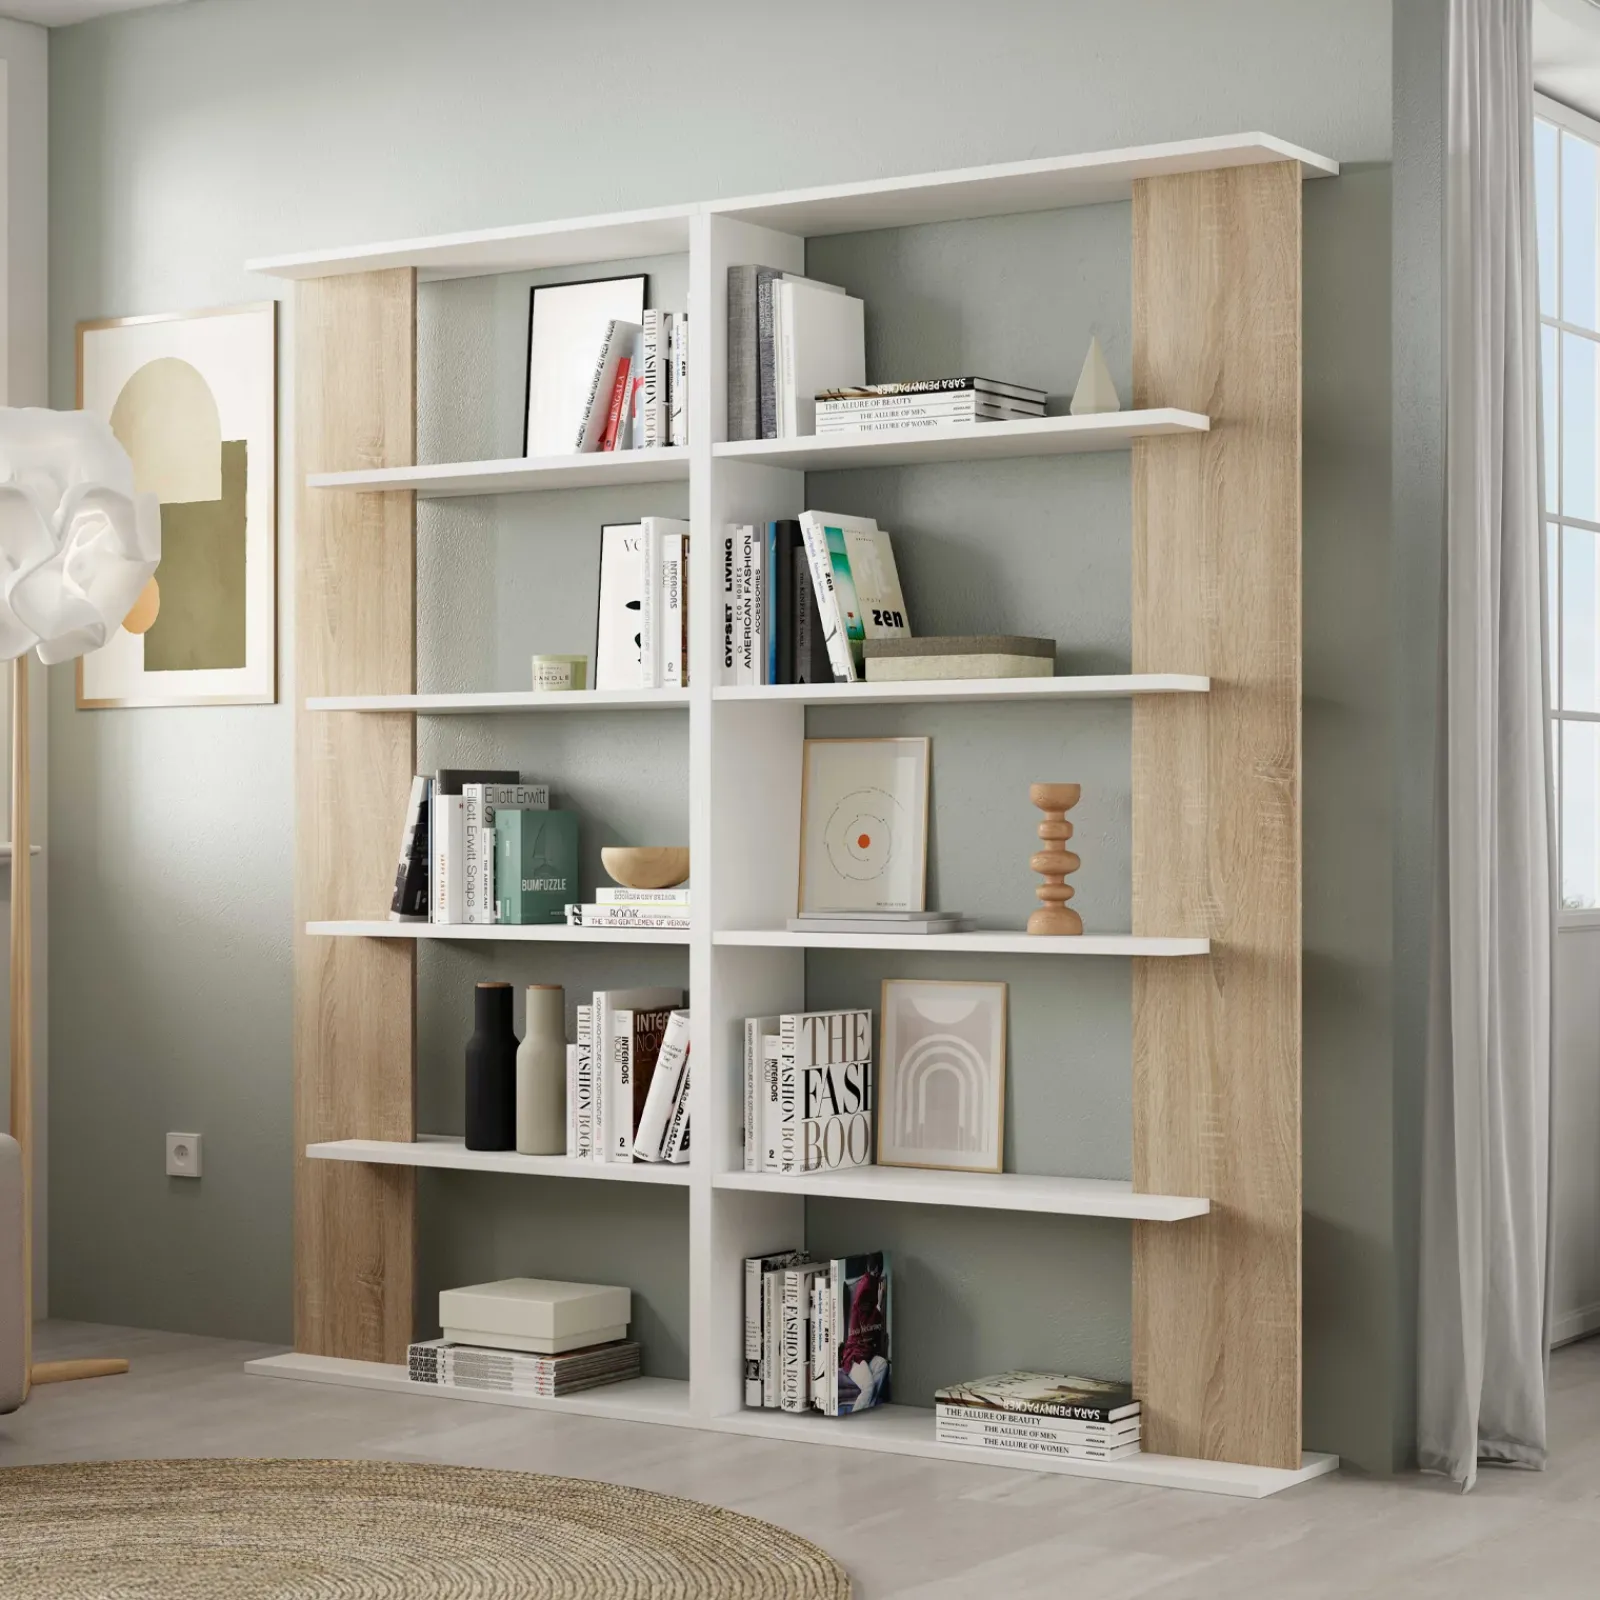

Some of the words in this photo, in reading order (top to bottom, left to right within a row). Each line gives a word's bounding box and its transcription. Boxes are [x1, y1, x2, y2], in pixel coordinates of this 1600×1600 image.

[644, 311, 656, 340] THE
[644, 344, 656, 404] FASHION
[942, 377, 966, 390] SARA
[824, 403, 840, 412] THE
[841, 400, 870, 410] ALLURE
[882, 398, 913, 406] BEAUTY
[860, 412, 872, 420] THE
[873, 410, 900, 419] ALLURE
[911, 408, 926, 416] MEN
[644, 408, 656, 448] BOOK
[859, 424, 872, 432] THE
[874, 422, 900, 431] ALLURE
[912, 419, 938, 428] WOMEN
[724, 538, 732, 592] LIVING
[744, 535, 752, 594] FASHION
[670, 560, 678, 609] INTERIORS
[824, 572, 834, 592] zen
[744, 598, 752, 669] AMERICAN
[872, 609, 904, 628] zen
[724, 603, 732, 668] GYPSET
[466, 787, 478, 821] Elliott
[484, 786, 514, 804] Elliott
[516, 786, 546, 804] Erwitt
[466, 826, 478, 861] Erwitt
[466, 865, 478, 908] Snaps
[522, 878, 567, 892] BUMFUZZLE
[578, 1008, 591, 1040] THE
[782, 1018, 794, 1050] THE
[802, 1012, 870, 1067] THE
[578, 1044, 591, 1110] FASHION
[782, 1054, 794, 1123] FASHION
[578, 1114, 591, 1158] BOOK
[619, 1137, 625, 1148] 2
[782, 1128, 794, 1173] BOOK
[786, 1274, 798, 1303] THE
[786, 1306, 798, 1365] FASHION
[945, 1408, 962, 1417] THE
[964, 1409, 995, 1421] ALLURE
[996, 1413, 1008, 1422] OF
[1008, 1415, 1042, 1426] BEAUTY
[1002, 1400, 1071, 1417] PENNYPACKER
[1074, 1406, 1100, 1420] SARA
[984, 1425, 998, 1434] THE
[1000, 1426, 1028, 1437] ALLURE
[1029, 1430, 1040, 1438] OF
[1040, 1432, 1057, 1440] MEN
[984, 1438, 998, 1446] THE
[1000, 1439, 1028, 1450] ALLURE
[1029, 1442, 1040, 1450] OF
[1040, 1444, 1070, 1454] WOMEN
